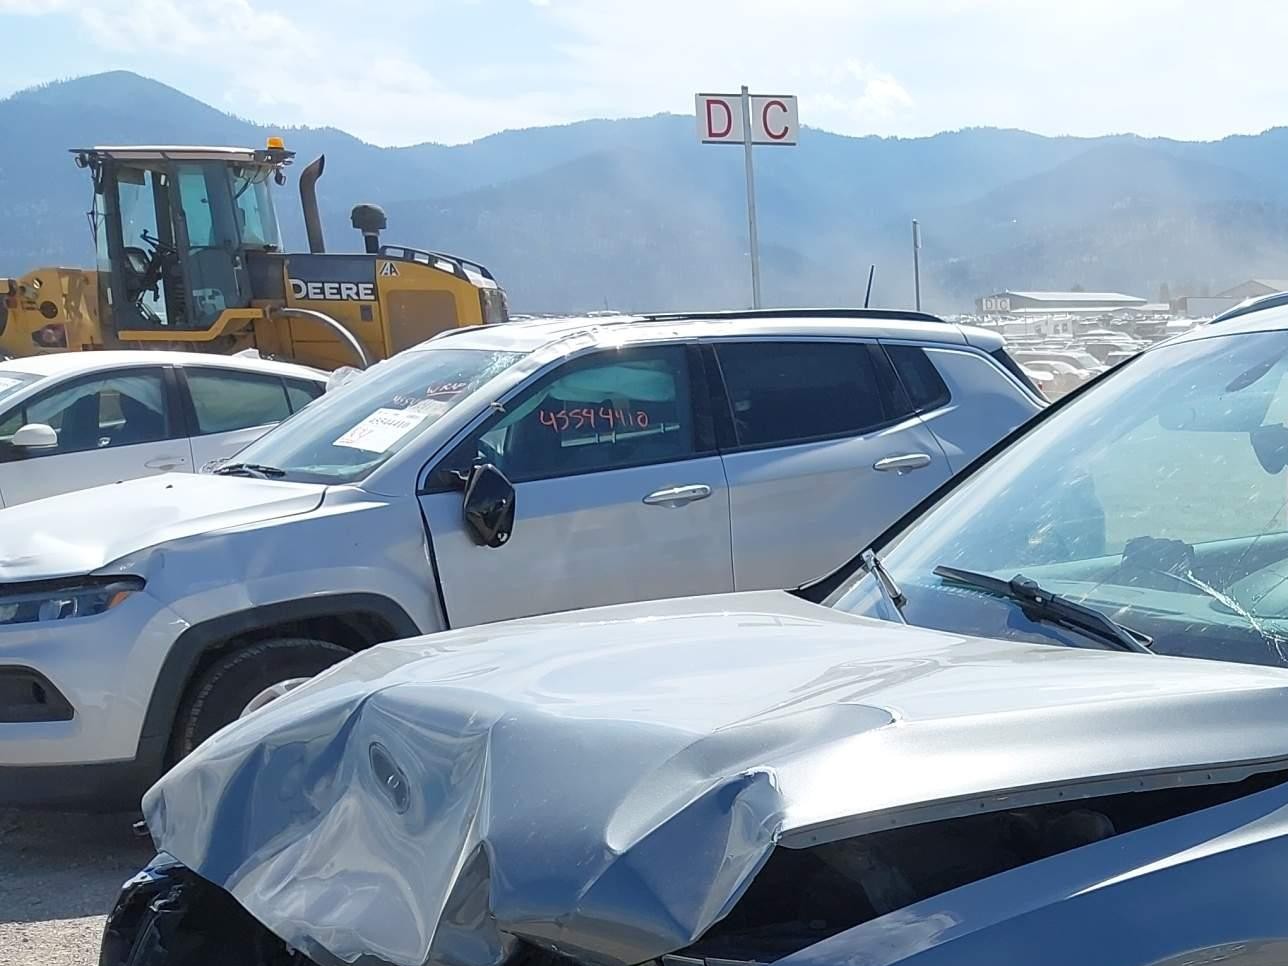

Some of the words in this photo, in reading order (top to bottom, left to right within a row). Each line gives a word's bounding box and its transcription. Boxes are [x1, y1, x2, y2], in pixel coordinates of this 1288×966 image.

[706, 99, 732, 138] D
[762, 100, 789, 139] C
[288, 279, 376, 300] DEERE
[540, 407, 649, 432] 45544410
